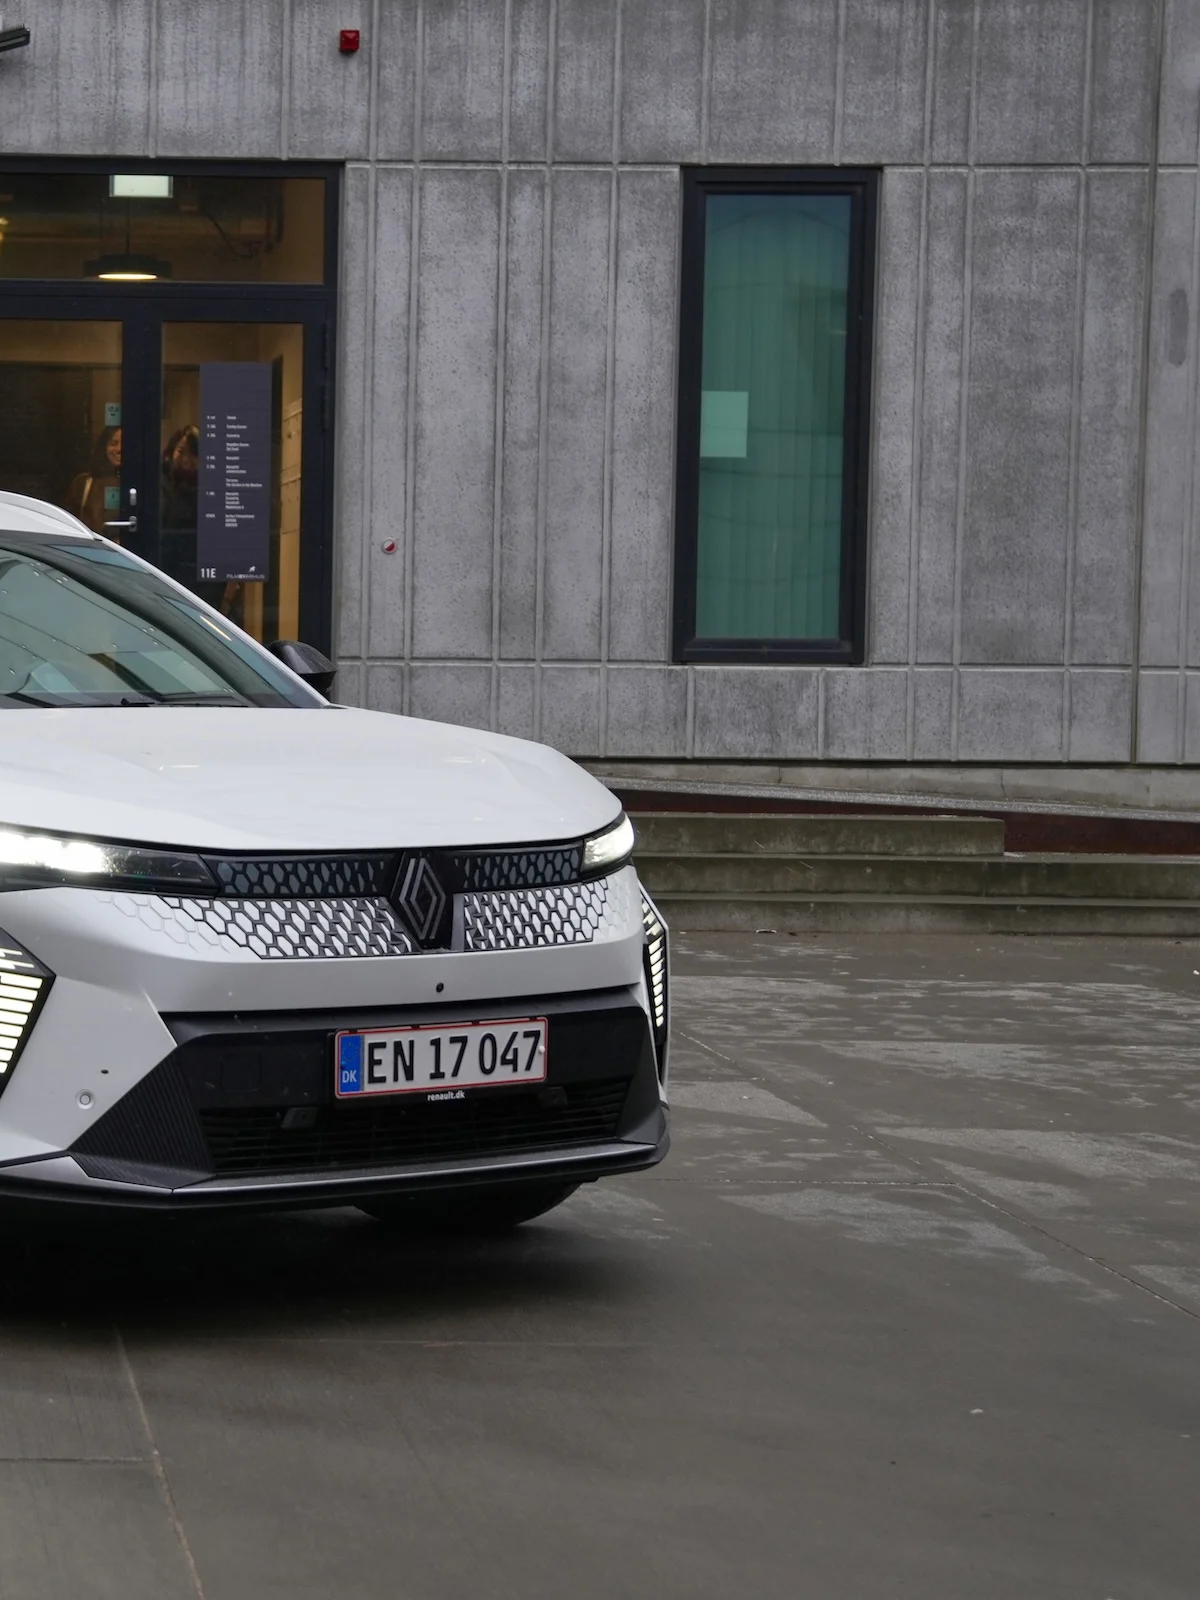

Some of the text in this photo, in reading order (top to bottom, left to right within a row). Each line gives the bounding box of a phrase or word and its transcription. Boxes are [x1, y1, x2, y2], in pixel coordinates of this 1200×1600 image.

[201, 568, 217, 578] 11E
[367, 1029, 541, 1084] EN 17 047
[342, 1069, 358, 1084] DK
[427, 1090, 466, 1101] renault.dk
